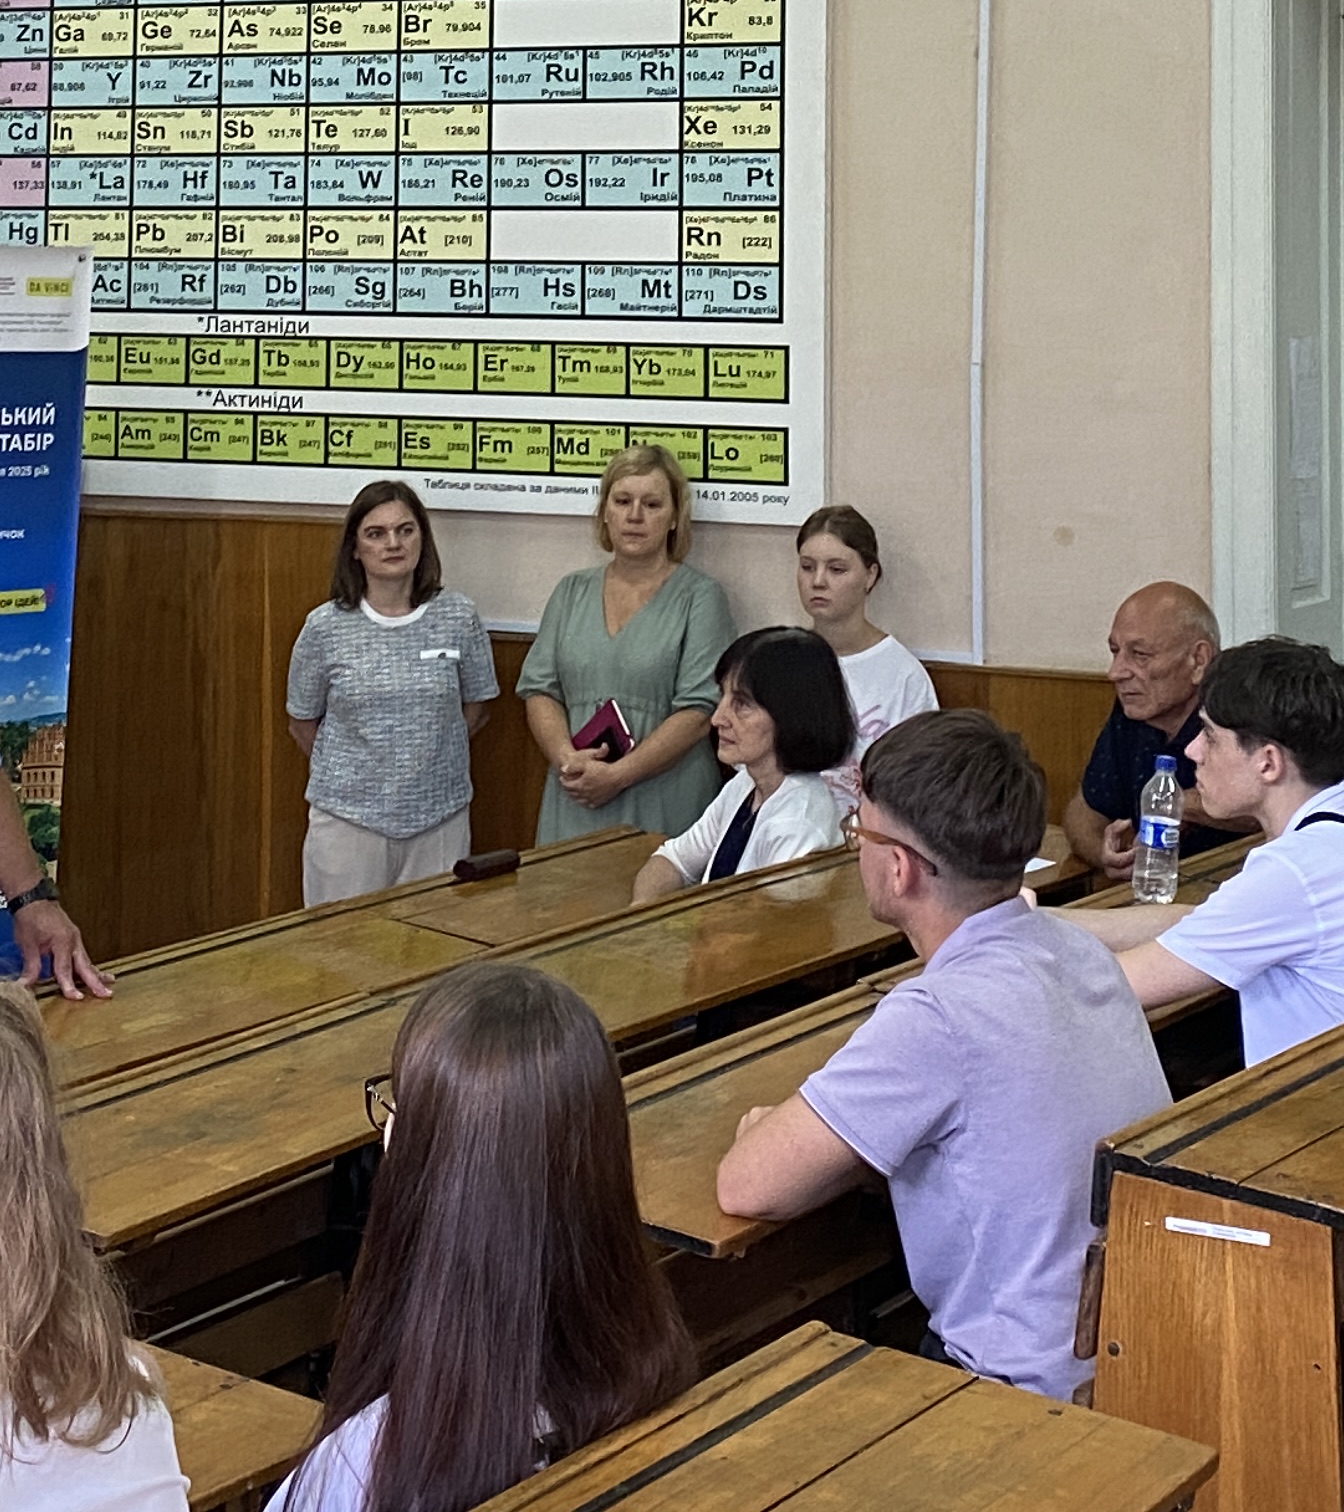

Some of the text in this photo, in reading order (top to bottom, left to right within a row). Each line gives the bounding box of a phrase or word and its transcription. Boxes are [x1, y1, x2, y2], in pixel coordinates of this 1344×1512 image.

[313, 16, 342, 35] Se
[404, 14, 433, 33] Br
[688, 7, 718, 27] Kr
[16, 24, 44, 42] Zn
[55, 24, 85, 42] Ga
[141, 21, 172, 39] Ge
[227, 19, 259, 38] As
[187, 70, 213, 89] Zr
[270, 68, 302, 88] Nb
[356, 67, 392, 86] Mo
[439, 65, 468, 85] Tc
[546, 63, 579, 83] Ru
[640, 61, 674, 81] Rh
[740, 60, 774, 80] Pd
[106, 72, 122, 91] Y
[8, 122, 38, 140] Cd
[136, 121, 165, 140] Sn
[224, 119, 254, 139] Sb
[311, 119, 338, 138] Te
[684, 115, 717, 135] Xe
[182, 170, 209, 189] Hf
[268, 171, 296, 190] Ta
[358, 170, 383, 189] W
[451, 169, 483, 188] Re
[544, 168, 579, 188] Os
[747, 167, 774, 187] Pt
[9, 222, 38, 245] Hg
[136, 223, 165, 242] Pb
[222, 224, 245, 243] Bi
[309, 225, 339, 244] Po
[399, 225, 427, 245] At
[686, 226, 721, 246] Rn
[91, 274, 122, 293] Ac
[181, 273, 207, 292] Rf
[265, 275, 297, 294] Db
[355, 276, 386, 300] Sg
[450, 279, 483, 298] Bh
[543, 277, 575, 297] Hs
[641, 279, 672, 299] Mt
[733, 280, 767, 301] Ds
[125, 347, 151, 364] Eu
[191, 348, 221, 366] Gd
[263, 349, 290, 367] Tb
[336, 351, 365, 373] Dy
[406, 352, 435, 370] Ho
[484, 354, 509, 372] Er
[558, 355, 591, 373] Tm
[633, 358, 662, 375] Yb
[713, 360, 741, 378] Lu
[120, 424, 151, 441] Am
[190, 426, 220, 443] Cm
[260, 429, 288, 447] Bk
[329, 429, 354, 448] Cf
[404, 431, 431, 450] Es
[479, 435, 513, 454] Fm
[556, 437, 590, 456] Md
[710, 441, 739, 461] Lo
